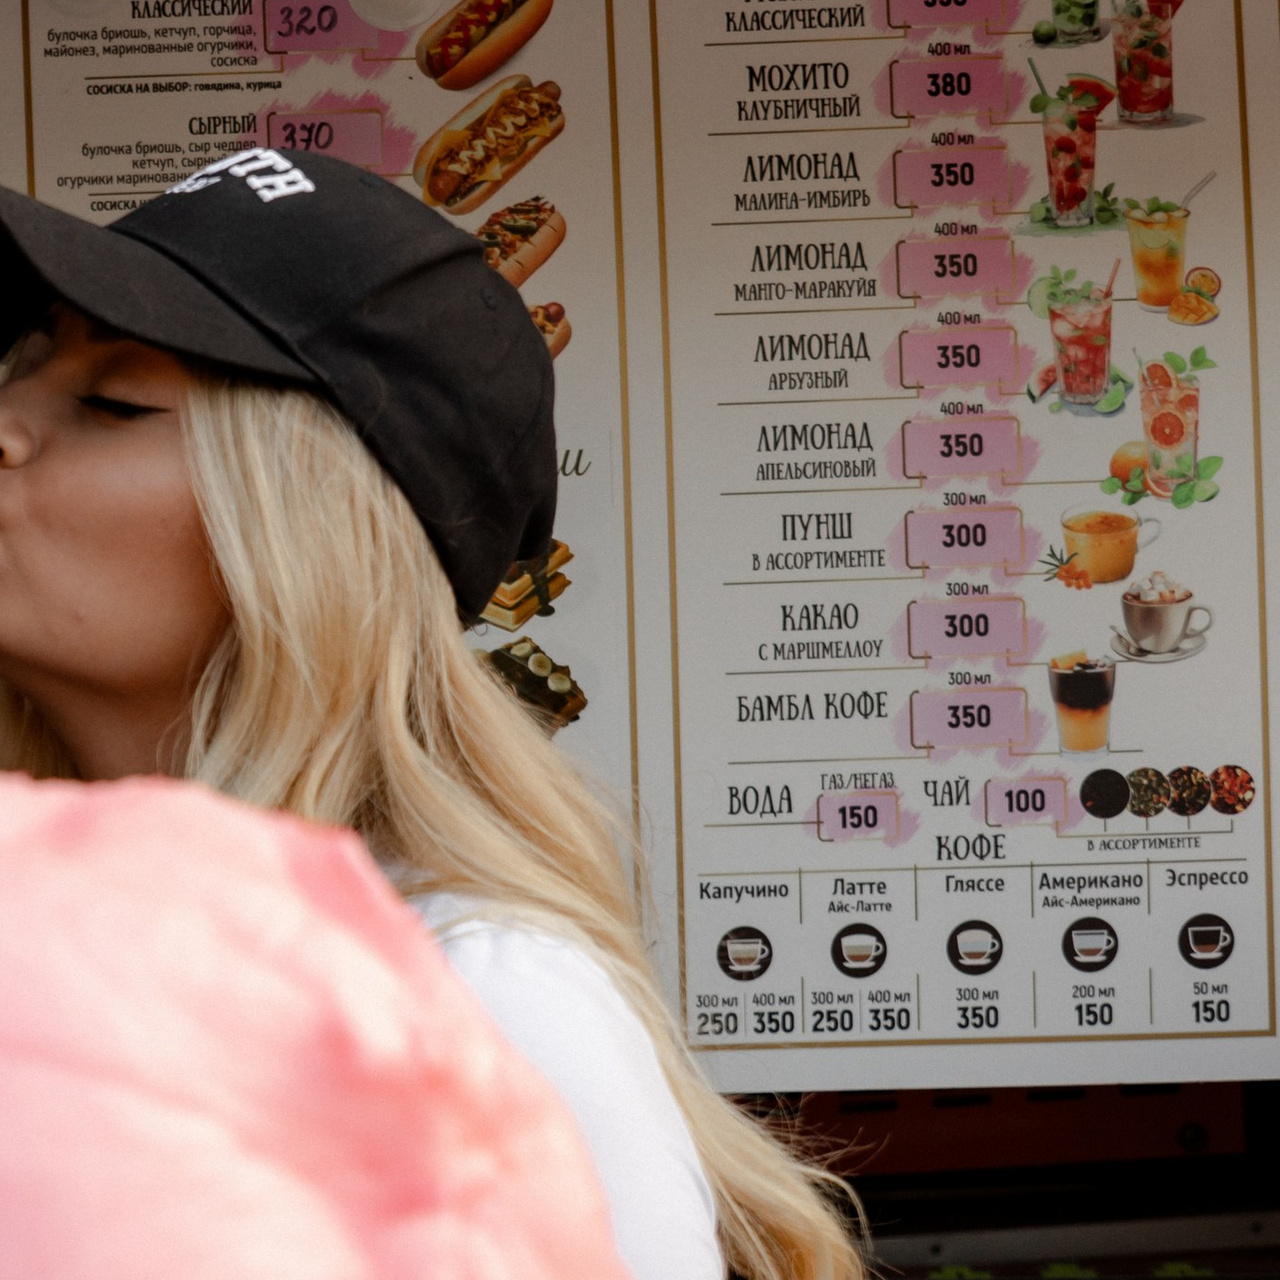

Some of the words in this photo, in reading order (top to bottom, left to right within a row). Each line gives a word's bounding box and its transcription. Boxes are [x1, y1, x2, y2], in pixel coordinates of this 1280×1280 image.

[278, 5, 337, 37] 320
[726, 4, 865, 32] КЛАССИЧЕСКИЙ
[48, 29, 97, 44] булочка
[101, 27, 150, 42] бриошь,
[154, 27, 199, 40] кетчуп,
[204, 24, 257, 38] горчица,
[43, 44, 100, 60] майонез,
[102, 41, 194, 57] маринованные
[196, 38, 256, 54] огурчики,
[928, 43, 951, 56] 400
[954, 45, 970, 55] мл
[211, 55, 258, 67] сосиска
[87, 84, 133, 95] СОСИСКА
[136, 84, 149, 92] НА
[152, 82, 190, 92] ВЫБОР:
[194, 83, 243, 91] говядина,
[246, 81, 282, 91] курица
[747, 63, 849, 92] МОХИТО
[928, 72, 971, 96] 380
[737, 94, 860, 121] КЛУБНИЧНЫЙ
[189, 113, 257, 135] СЫРНЫЙ
[281, 122, 333, 149] 370
[932, 133, 955, 146] 400
[958, 135, 974, 144] мл
[82, 143, 132, 159] булочка
[135, 141, 185, 157] бриошь,
[189, 142, 211, 154] сыр
[132, 158, 177, 171] кетчуп,
[744, 152, 860, 182] ЛИМОНАД
[931, 163, 974, 186] 350
[57, 176, 113, 189] огурчики
[90, 199, 137, 212] СОСИСКА
[735, 189, 870, 211] МАЛИНА-ИМБИРЬ
[935, 223, 958, 236] 400
[961, 225, 977, 235] мл
[752, 242, 867, 272] ЛИМОНАД
[935, 254, 977, 277] 350
[734, 278, 876, 301] МАНГО-МАРАКУЙЯ
[938, 312, 961, 325] 400
[964, 314, 980, 324] мл
[755, 332, 870, 362] ЛИМОНАД
[938, 344, 980, 368] 350
[769, 369, 848, 390] АРБУЗНЫЙ
[941, 402, 964, 415] 400
[967, 404, 983, 414] мл
[758, 422, 873, 451] ЛИМОНАД
[941, 434, 983, 457] 350
[757, 458, 876, 480] АПЕЛЬСИНОВЫЙ
[944, 493, 966, 506] 300
[969, 495, 986, 505] мл
[782, 513, 852, 541] ПУНШ
[943, 524, 986, 547] 300
[753, 554, 760, 571] В
[766, 549, 885, 570] АССОРТИМЕНТЕ
[947, 583, 969, 596] 300
[972, 585, 988, 595] мл
[782, 603, 858, 631] КАКАО
[945, 614, 988, 637] 300
[759, 644, 767, 660] С
[773, 640, 882, 660] МАРШМЕЛЛОУ
[949, 672, 971, 685] 300
[974, 674, 991, 684] мл
[738, 694, 814, 722] БАМБЛ
[825, 691, 887, 719] КОФЕ
[948, 705, 990, 728] 350
[729, 785, 792, 817] ВОДА
[924, 777, 970, 806] ЧАЙ
[1005, 789, 1045, 812] 100
[839, 805, 877, 828] 150
[937, 834, 1005, 860] КОФЕ
[1088, 840, 1094, 851] В
[1101, 837, 1199, 850] АССОРТИМЕНТЕ
[833, 878, 886, 895] Латте
[946, 875, 1004, 892] Гляссе
[1039, 873, 1143, 893] Американо
[1167, 869, 1248, 890] Эспрессо
[700, 883, 788, 903] Капучино
[1043, 896, 1140, 909] Айс-Американо
[828, 900, 892, 912] Айс-Латте
[753, 993, 775, 1006] 400
[779, 996, 794, 1005] мл
[812, 992, 833, 1004] 300
[837, 994, 853, 1003] мл
[868, 990, 891, 1003] 400
[894, 993, 910, 1002] мл
[957, 988, 979, 1001] 300
[983, 991, 998, 1000] мл
[1073, 985, 1095, 998] 200
[1099, 988, 1115, 997] мл
[1194, 982, 1208, 995] 50
[1212, 984, 1228, 994] мл
[697, 995, 718, 1007] 300
[722, 997, 738, 1006] мл
[1193, 1000, 1229, 1022] 150
[698, 1013, 738, 1035] 250
[754, 1011, 794, 1033] 350
[813, 1010, 853, 1032] 250
[870, 1008, 910, 1031] 350
[958, 1006, 998, 1028] 350
[1076, 1003, 1112, 1025] 150
